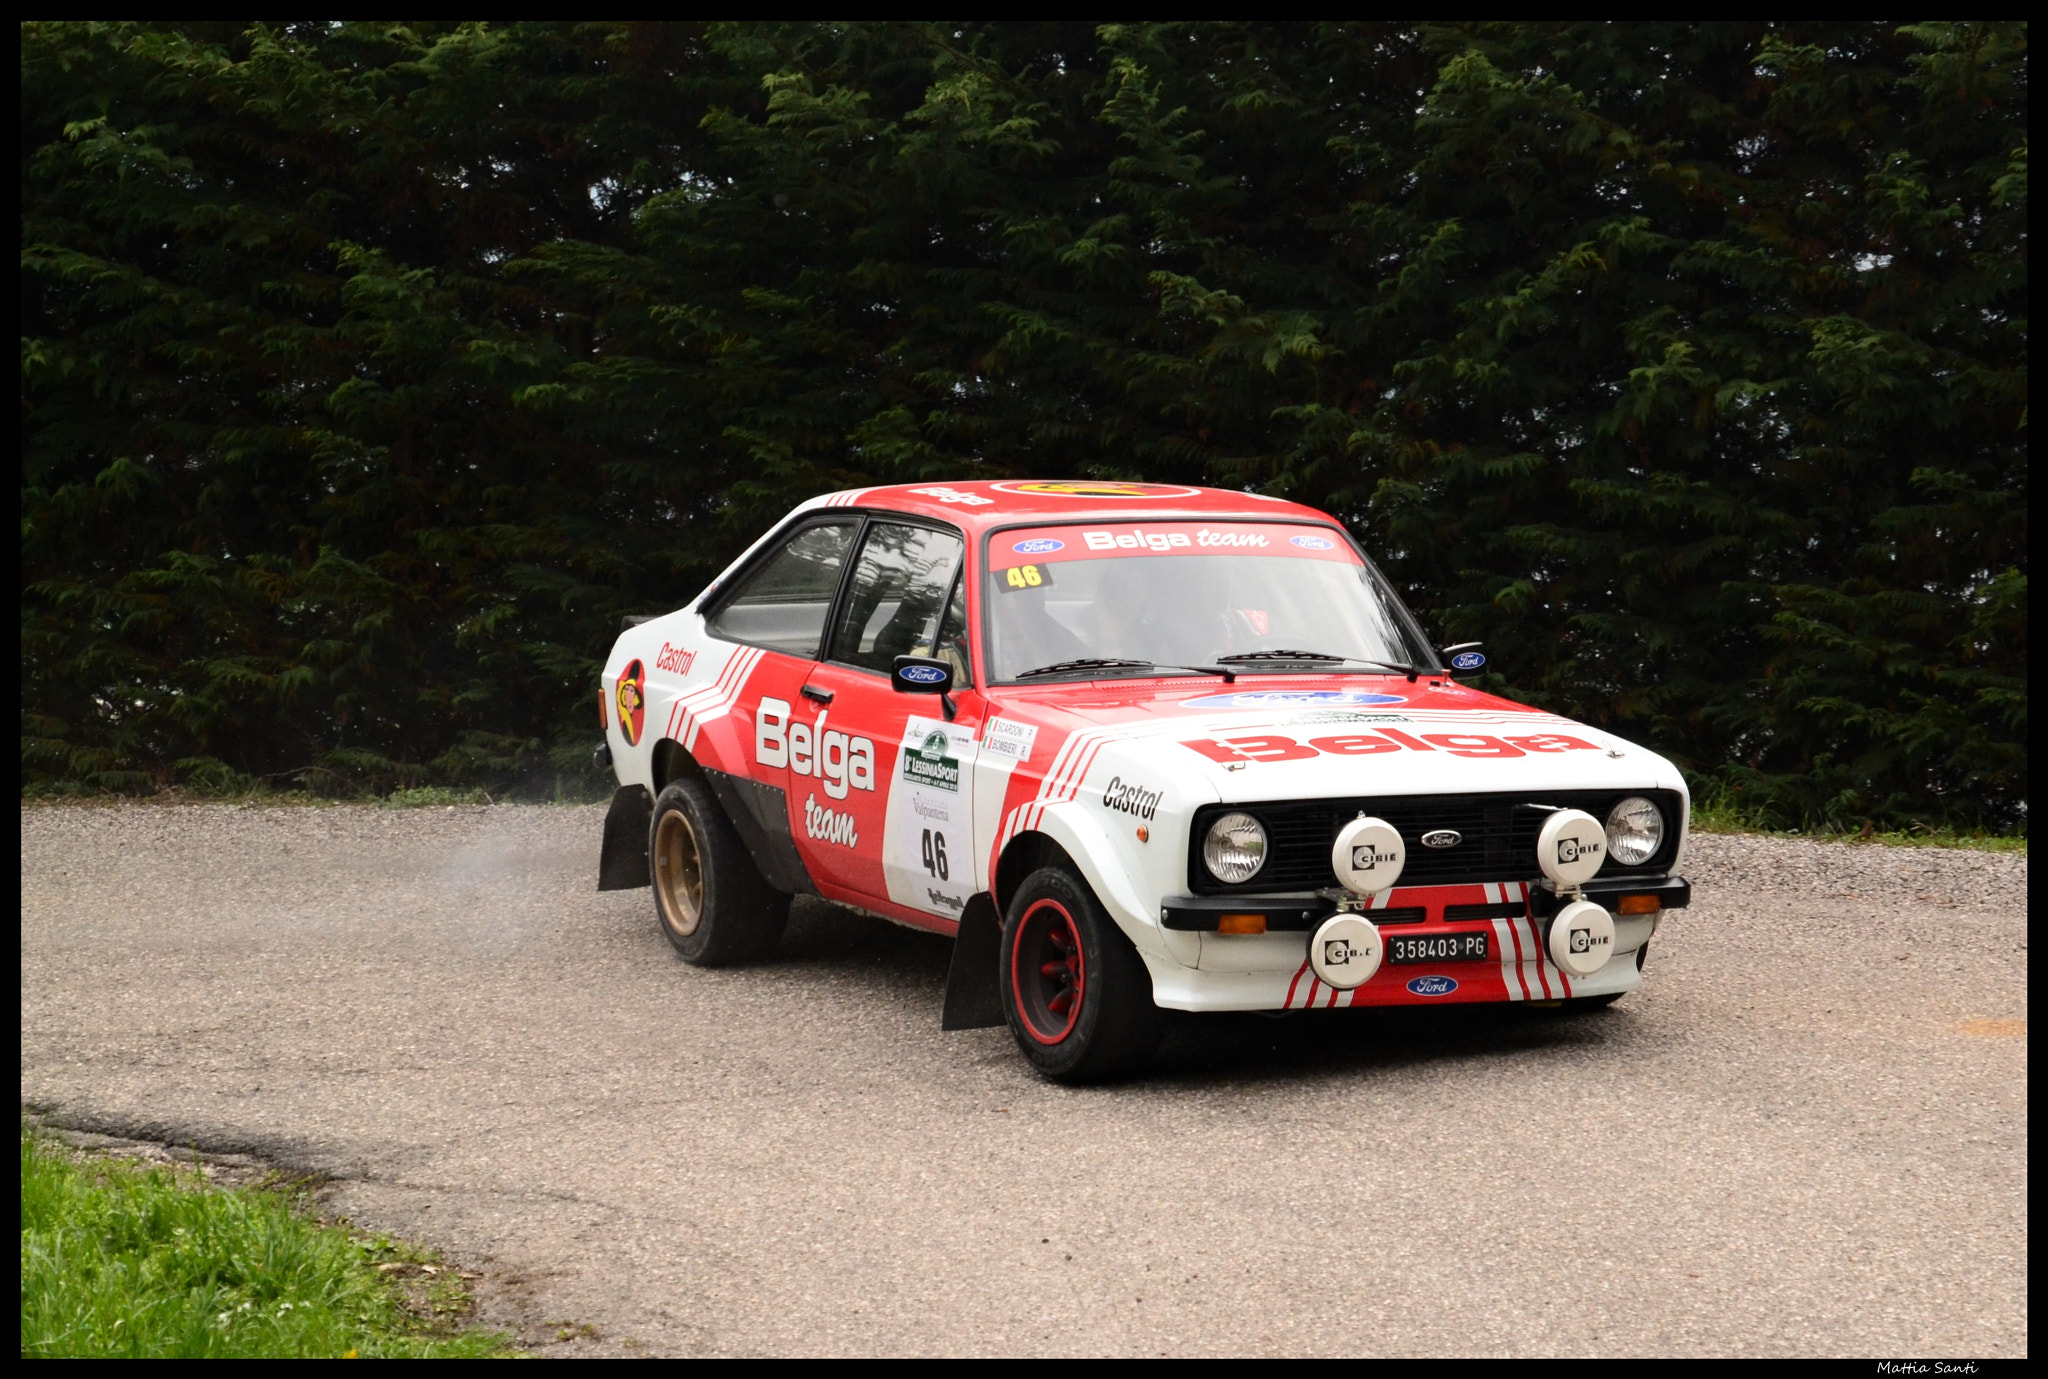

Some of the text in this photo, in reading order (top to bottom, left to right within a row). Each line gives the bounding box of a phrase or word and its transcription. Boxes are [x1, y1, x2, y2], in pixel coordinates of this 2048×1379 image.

[907, 486, 995, 506] Belga
[1082, 528, 1270, 551] Belga team
[1006, 565, 1042, 588] 46
[656, 641, 698, 677] Castrol
[1458, 654, 1479, 667] Ford
[908, 667, 937, 680] Ford
[755, 695, 876, 800] Belga
[1177, 728, 1604, 763] Belga
[1103, 776, 1163, 821] Castrol
[804, 792, 858, 849] team
[1431, 834, 1454, 845] Ford
[922, 828, 949, 881] 46
[1396, 937, 1484, 959] 358403 PG
[1416, 977, 1448, 993] Ford
